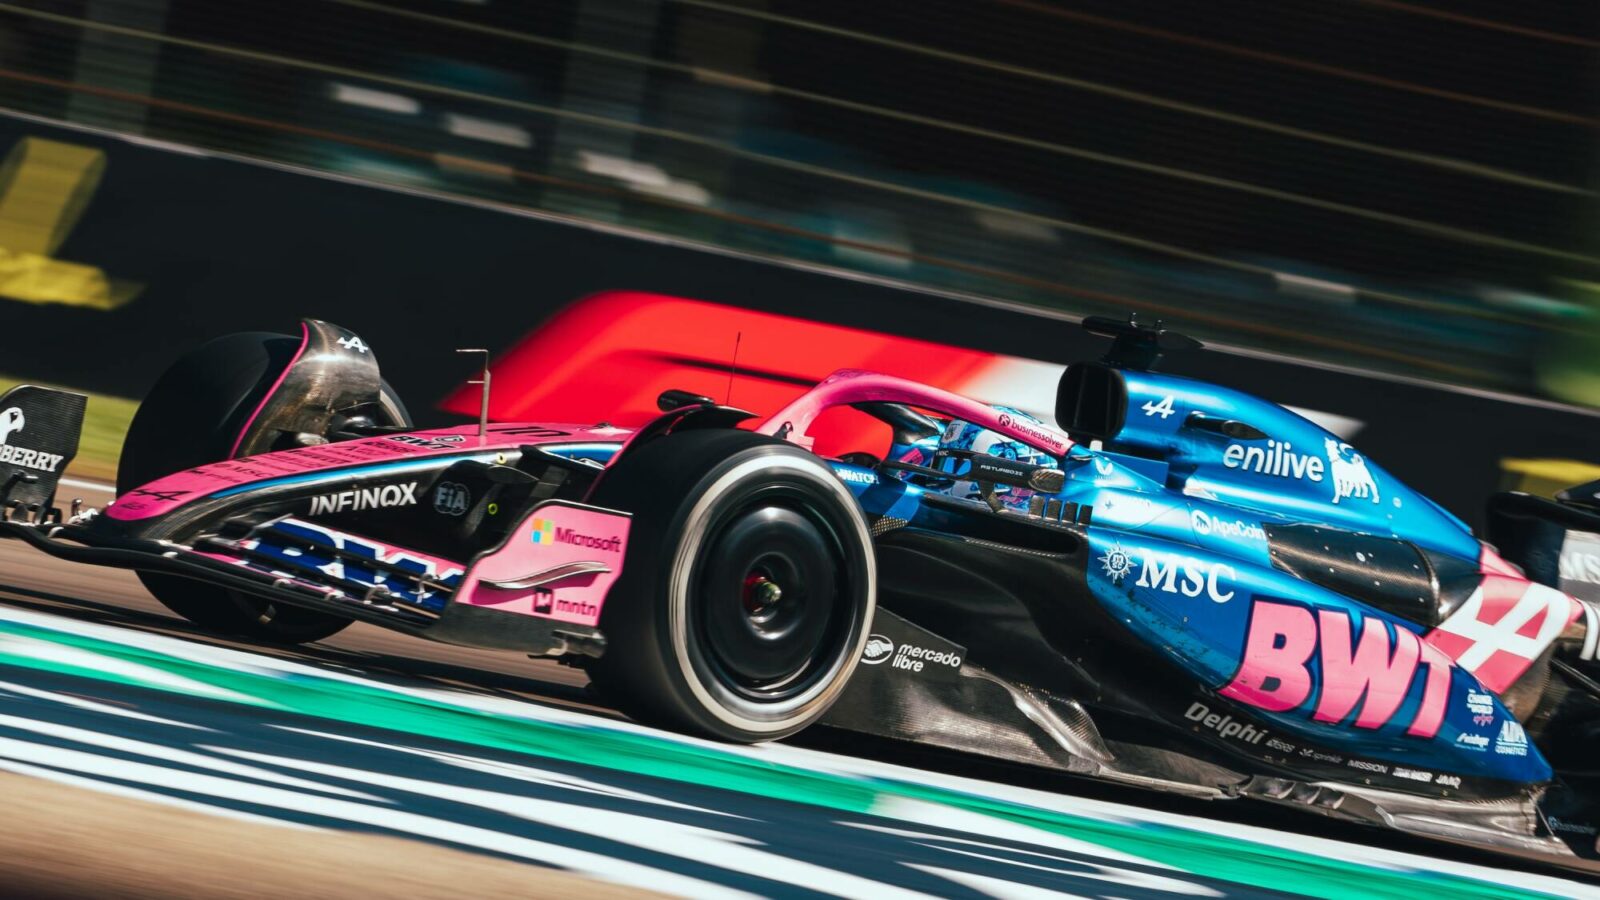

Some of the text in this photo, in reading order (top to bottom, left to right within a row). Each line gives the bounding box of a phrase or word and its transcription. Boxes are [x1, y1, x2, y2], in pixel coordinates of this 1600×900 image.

[1011, 419, 1064, 449] businessolver
[0, 444, 64, 472] BERRY
[1223, 440, 1325, 482] enilive
[309, 482, 417, 516] INFINOX
[555, 527, 621, 552] Microsoft
[1212, 516, 1268, 541] ApeCoin
[1136, 548, 1237, 603] MSC
[556, 599, 597, 616] mntn
[892, 654, 924, 672] libre
[898, 644, 962, 667] mercado
[1217, 600, 1457, 738] BWT
[1184, 702, 1269, 744] Delphi
[1347, 759, 1389, 774] MISSION
